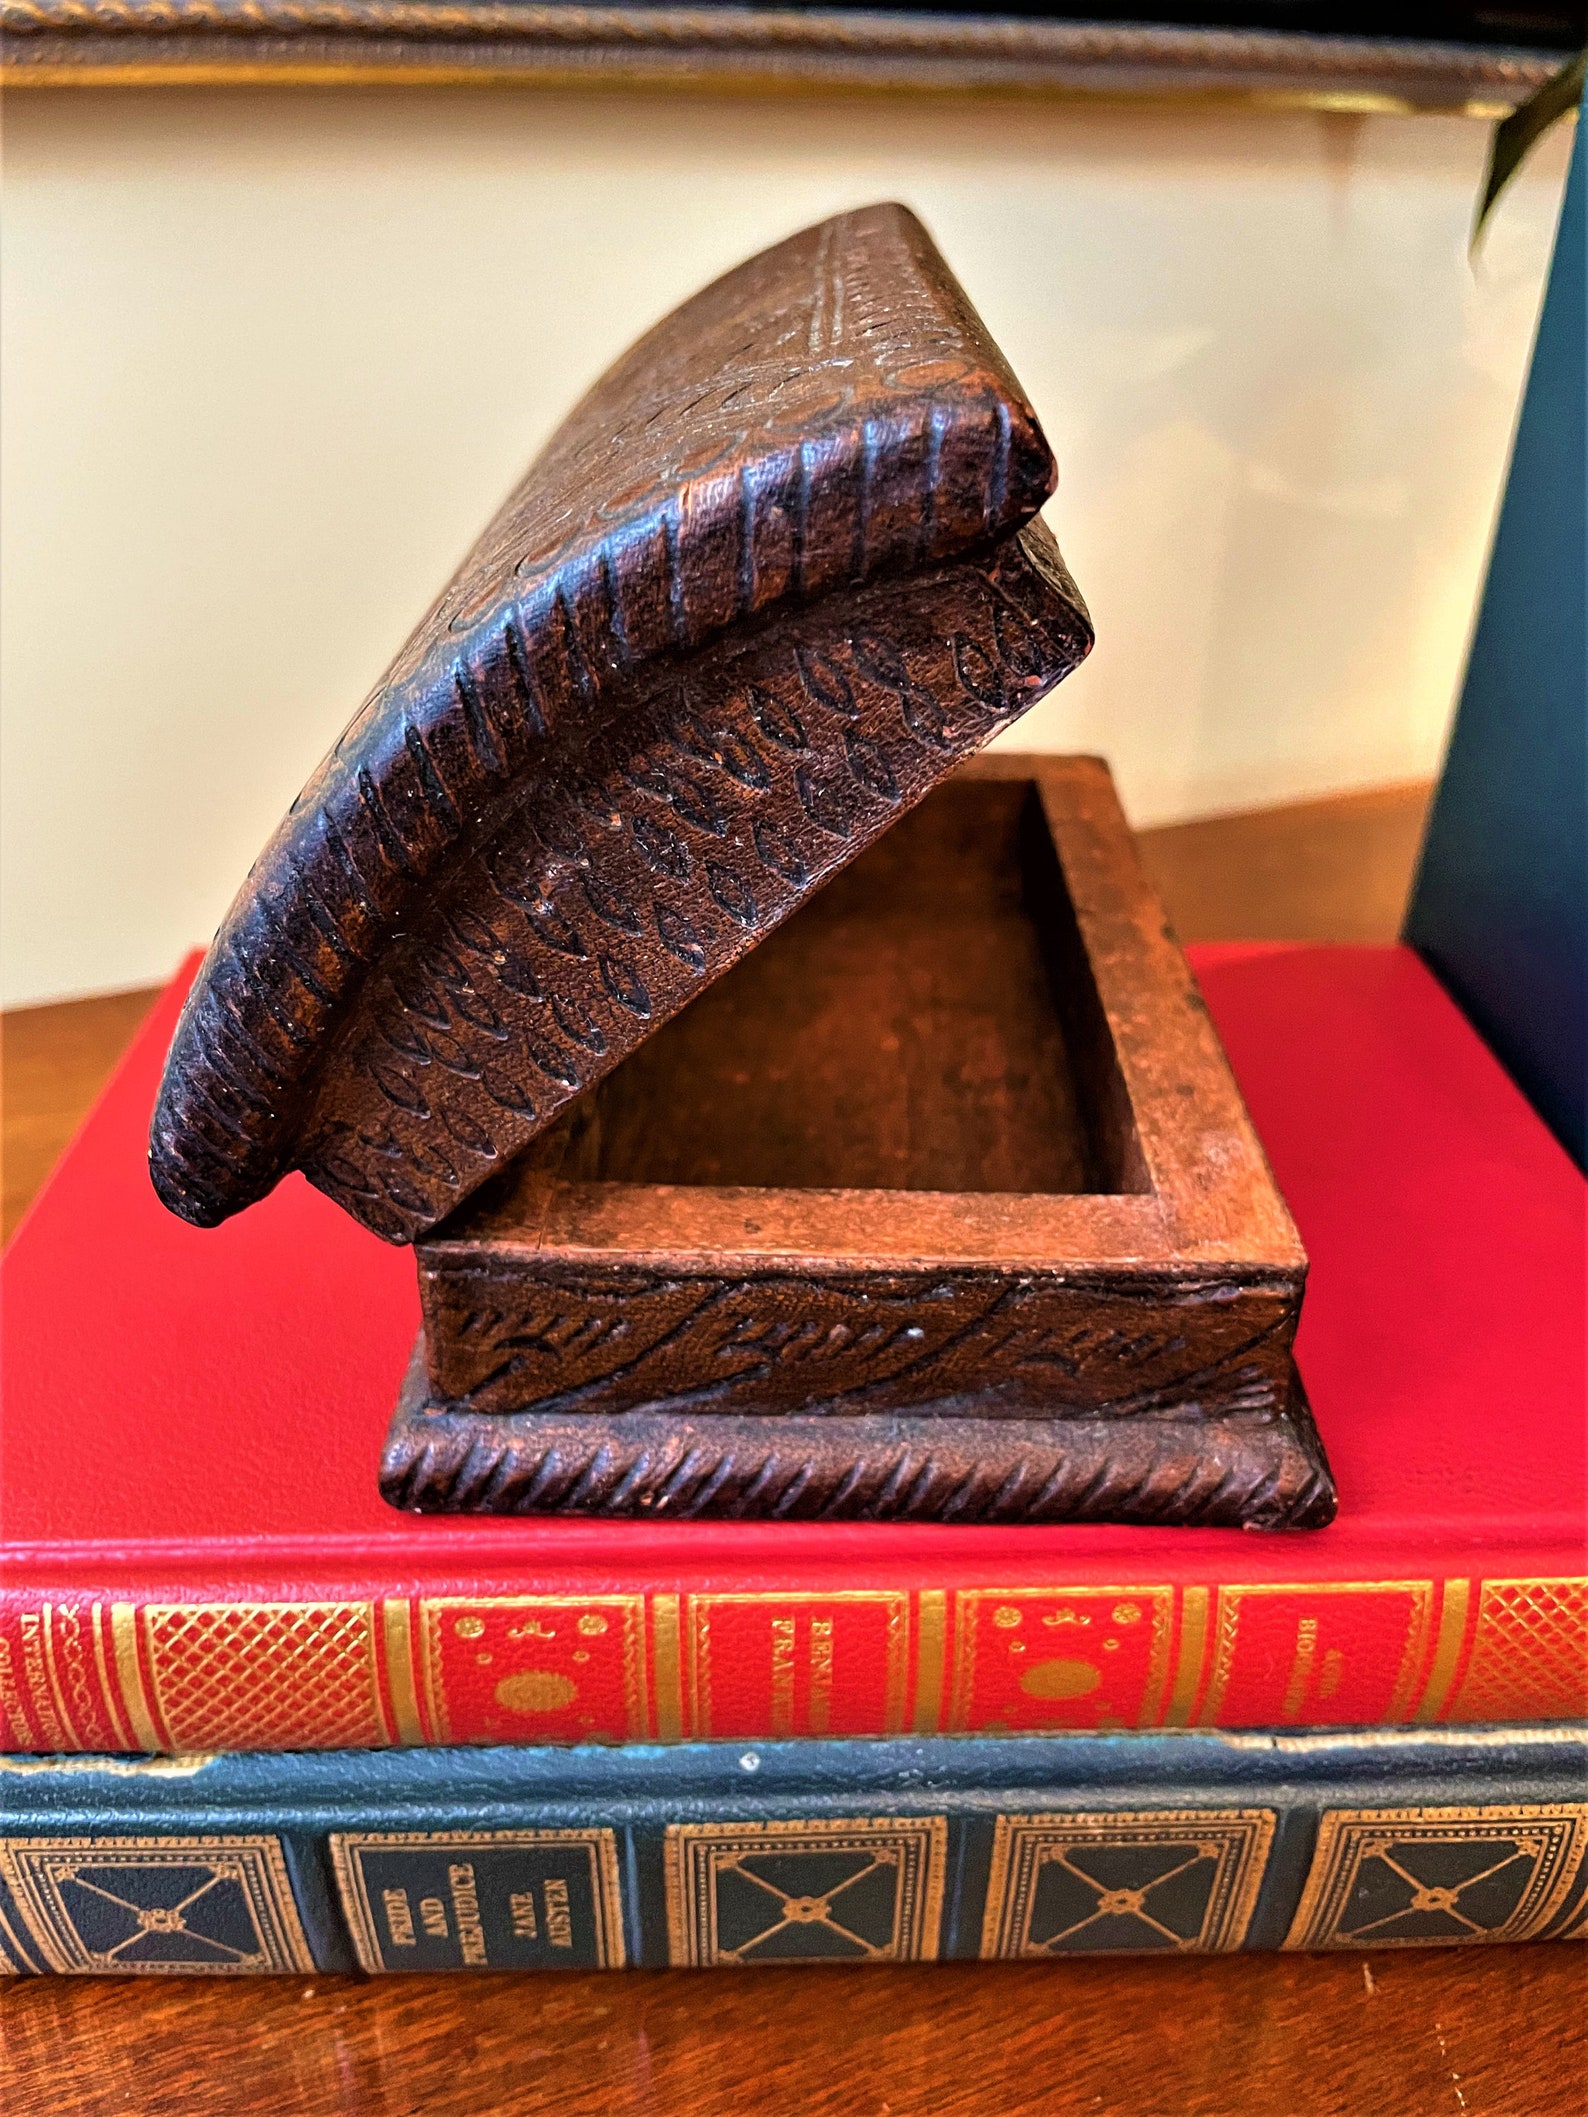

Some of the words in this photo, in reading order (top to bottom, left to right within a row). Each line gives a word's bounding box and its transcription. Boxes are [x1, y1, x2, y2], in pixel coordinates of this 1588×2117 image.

[382, 1888, 417, 1946] PRIDE
[420, 1897, 449, 1938] AND
[449, 1862, 488, 1966] PREJUDICE
[510, 1891, 538, 1939] JANE
[544, 1878, 573, 1947] AUSTEN
